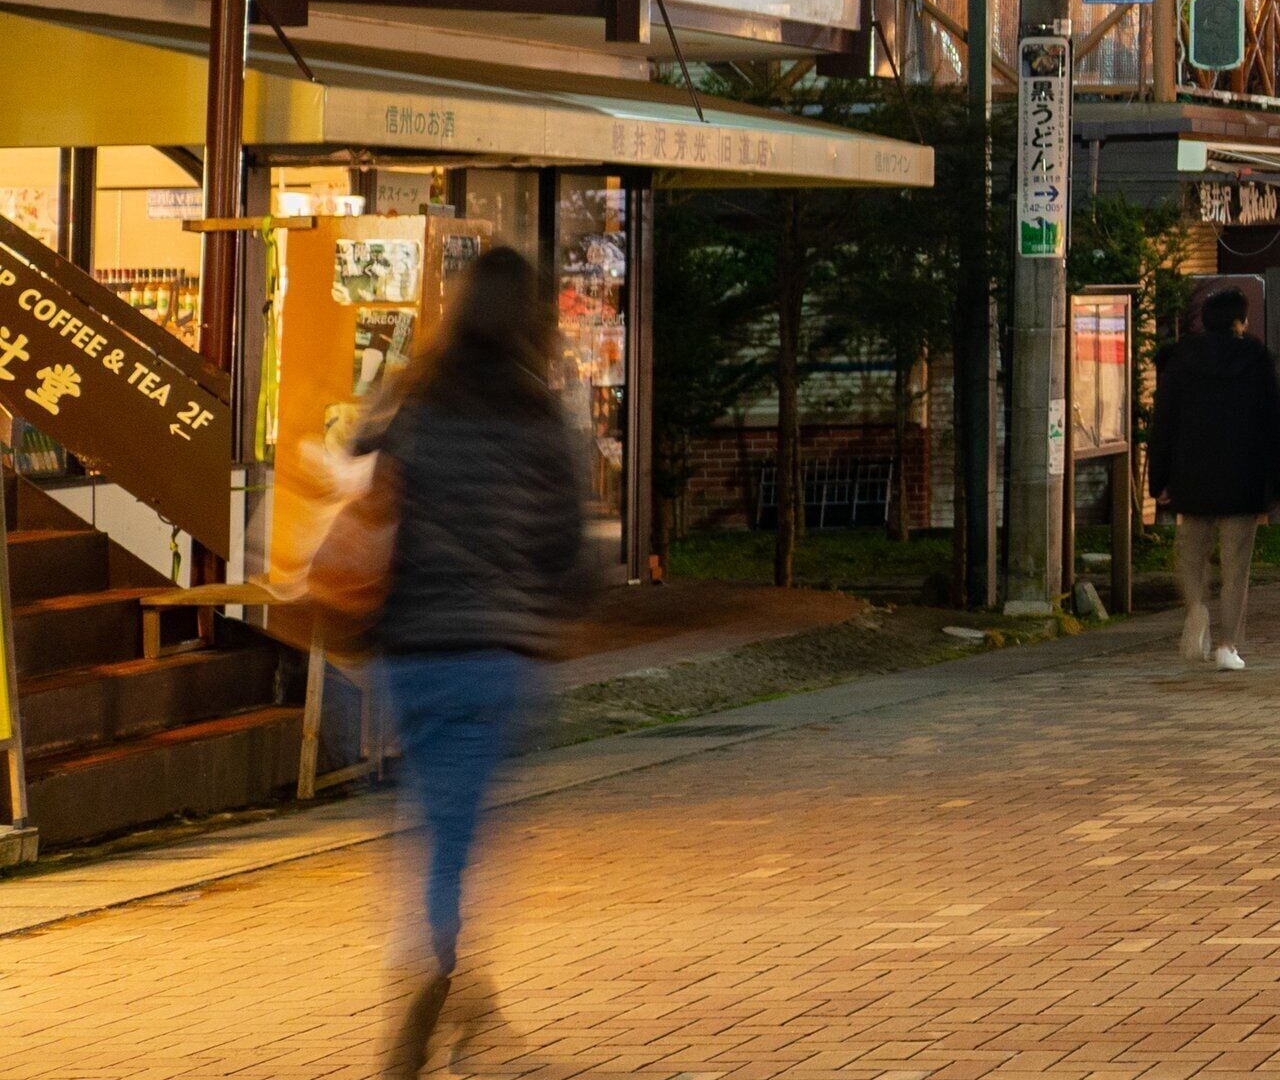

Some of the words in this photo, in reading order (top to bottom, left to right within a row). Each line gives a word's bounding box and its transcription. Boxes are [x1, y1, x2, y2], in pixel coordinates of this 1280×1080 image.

[385, 105, 456, 138] 信州のお酒
[1030, 79, 1055, 172] 黒うどん
[18, 288, 109, 358] COFFEE
[102, 348, 126, 375] &
[127, 362, 172, 407] TEA
[176, 400, 215, 430] 2F
